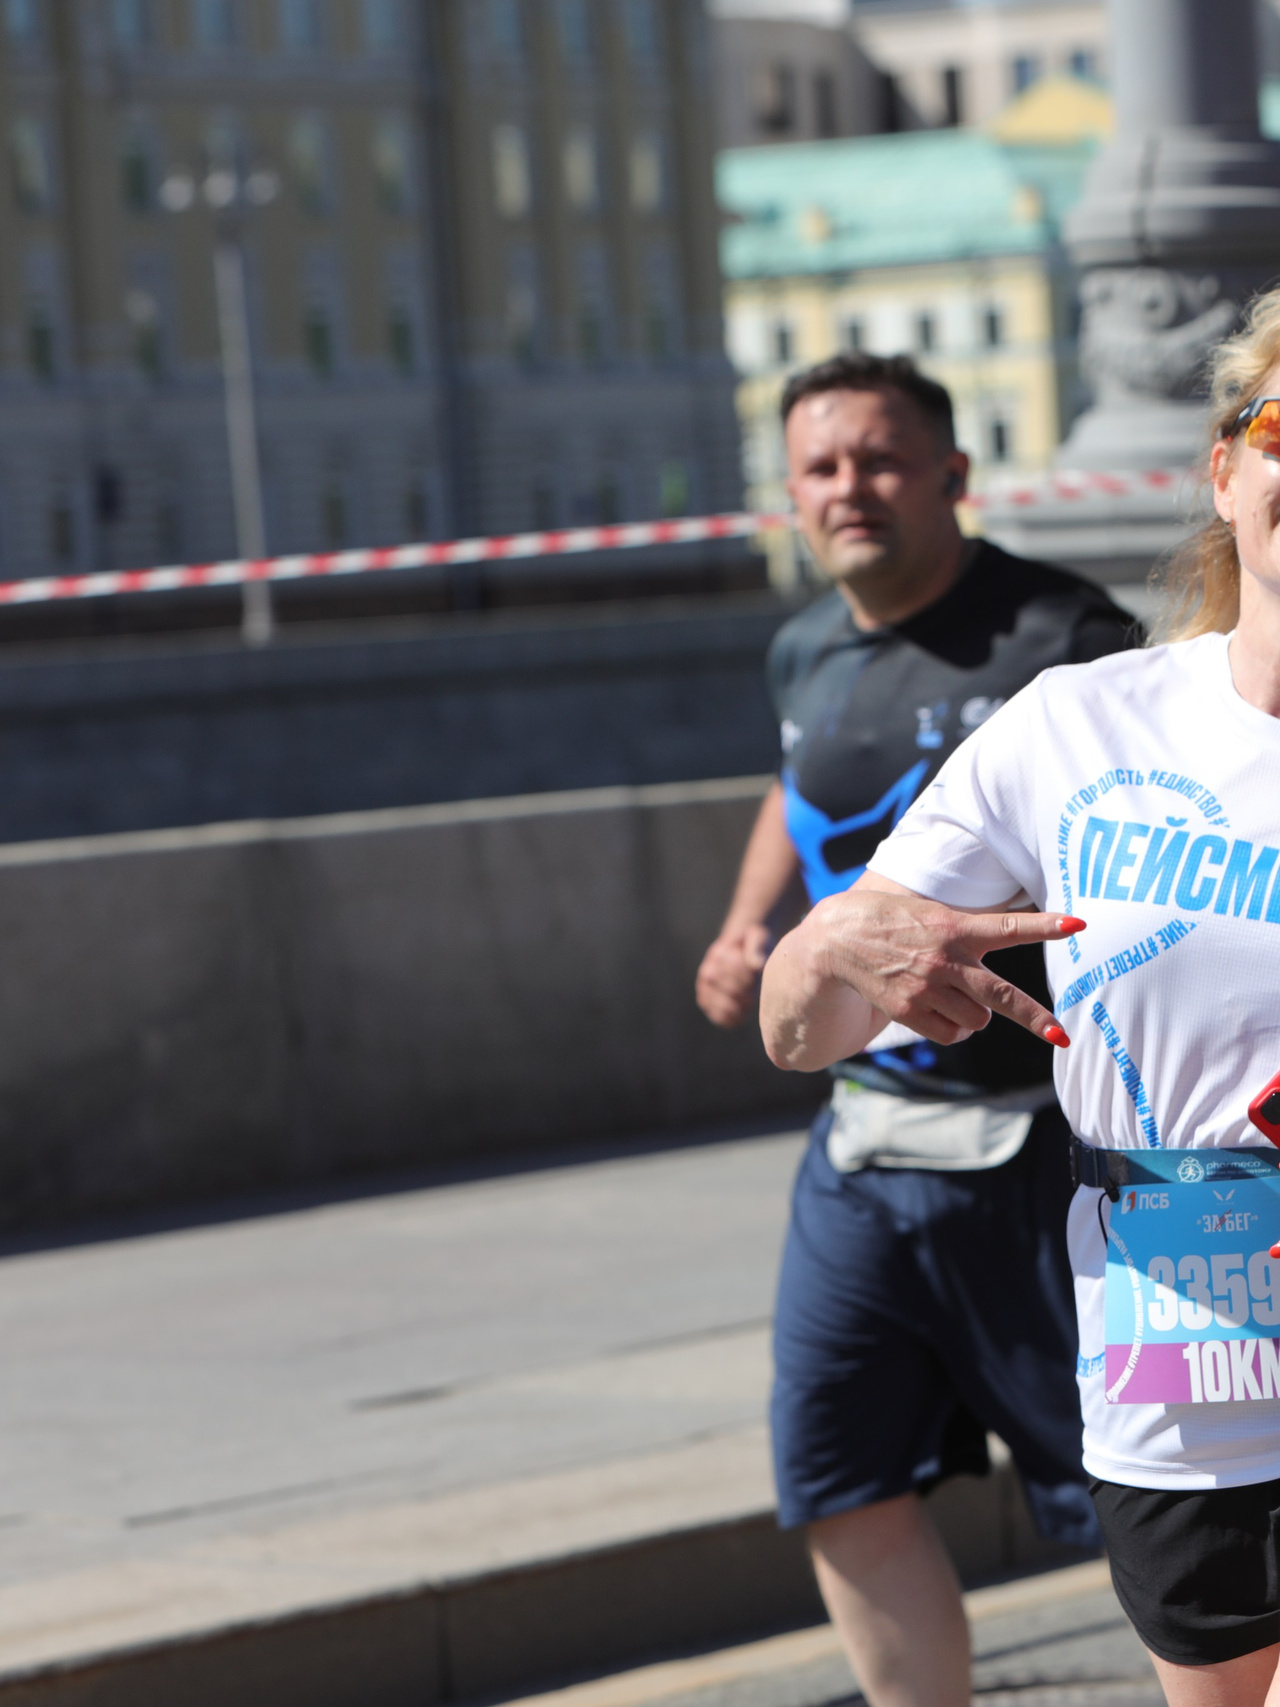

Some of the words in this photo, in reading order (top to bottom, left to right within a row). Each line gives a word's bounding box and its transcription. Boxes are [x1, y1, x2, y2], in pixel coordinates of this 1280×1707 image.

[1065, 768, 1145, 817] #ГОРДОСТЬ
[1148, 769, 1223, 819] #ЕДИНСТВО
[1104, 935, 1159, 982] #ТРЕПЕТ
[1091, 1001, 1121, 1049] #ЦЕЛЬ
[1112, 1047, 1152, 1116] #МОМЕНТ
[1138, 1193, 1170, 1210] ПСБ
